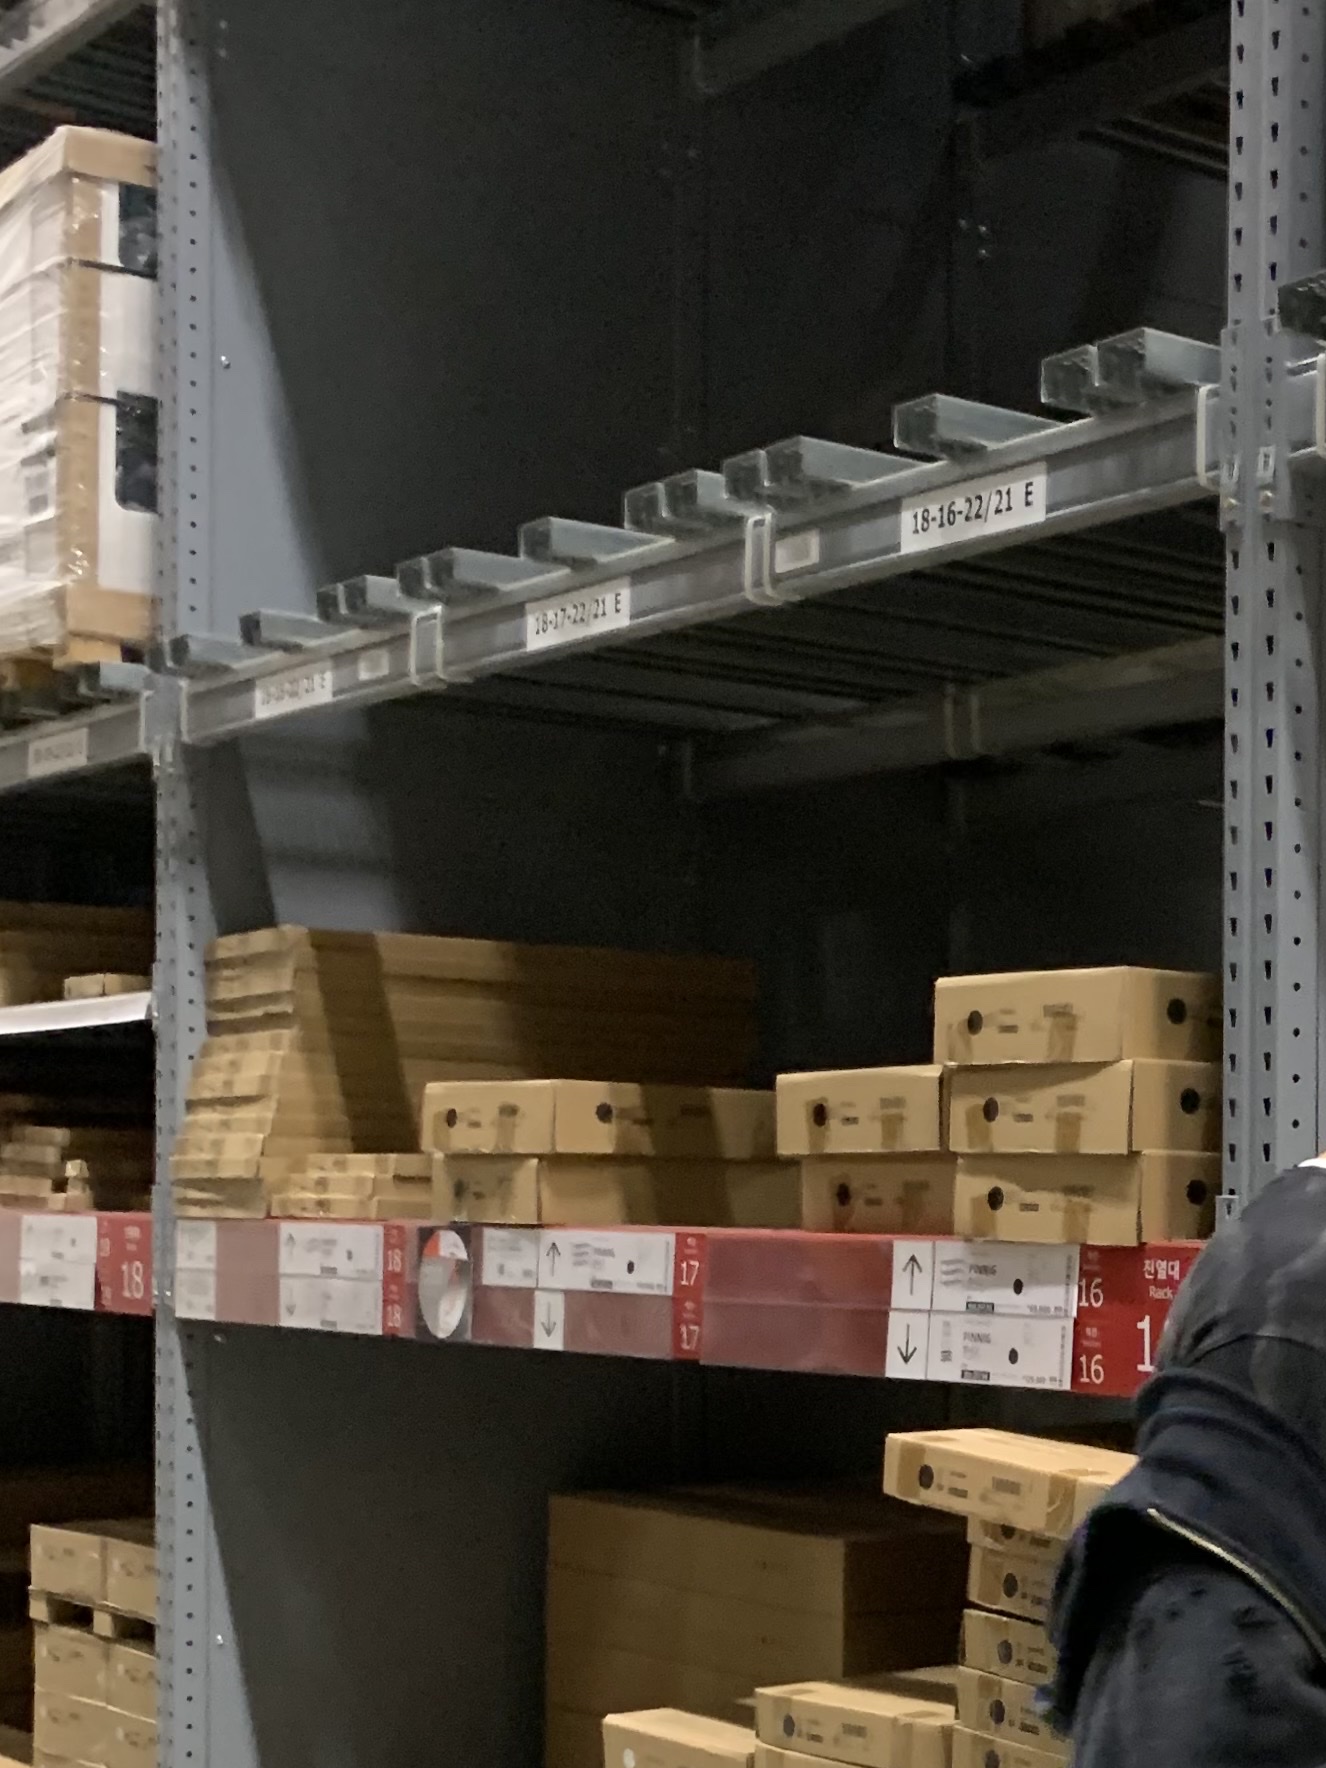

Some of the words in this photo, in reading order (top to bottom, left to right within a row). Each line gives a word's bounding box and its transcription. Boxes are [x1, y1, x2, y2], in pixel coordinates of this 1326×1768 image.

[912, 486, 1013, 535] 18-16-22/21
[1024, 480, 1034, 507] E
[535, 595, 607, 636] 18-17-22/21
[614, 592, 622, 614] E
[120, 1259, 145, 1300] 18
[680, 1259, 700, 1287] 17
[1143, 1259, 1180, 1280] 진열대
[1078, 1277, 1104, 1308] 16
[1149, 1285, 1173, 1300] Rack
[680, 1323, 700, 1350] 17
[1079, 1353, 1105, 1385] 16
